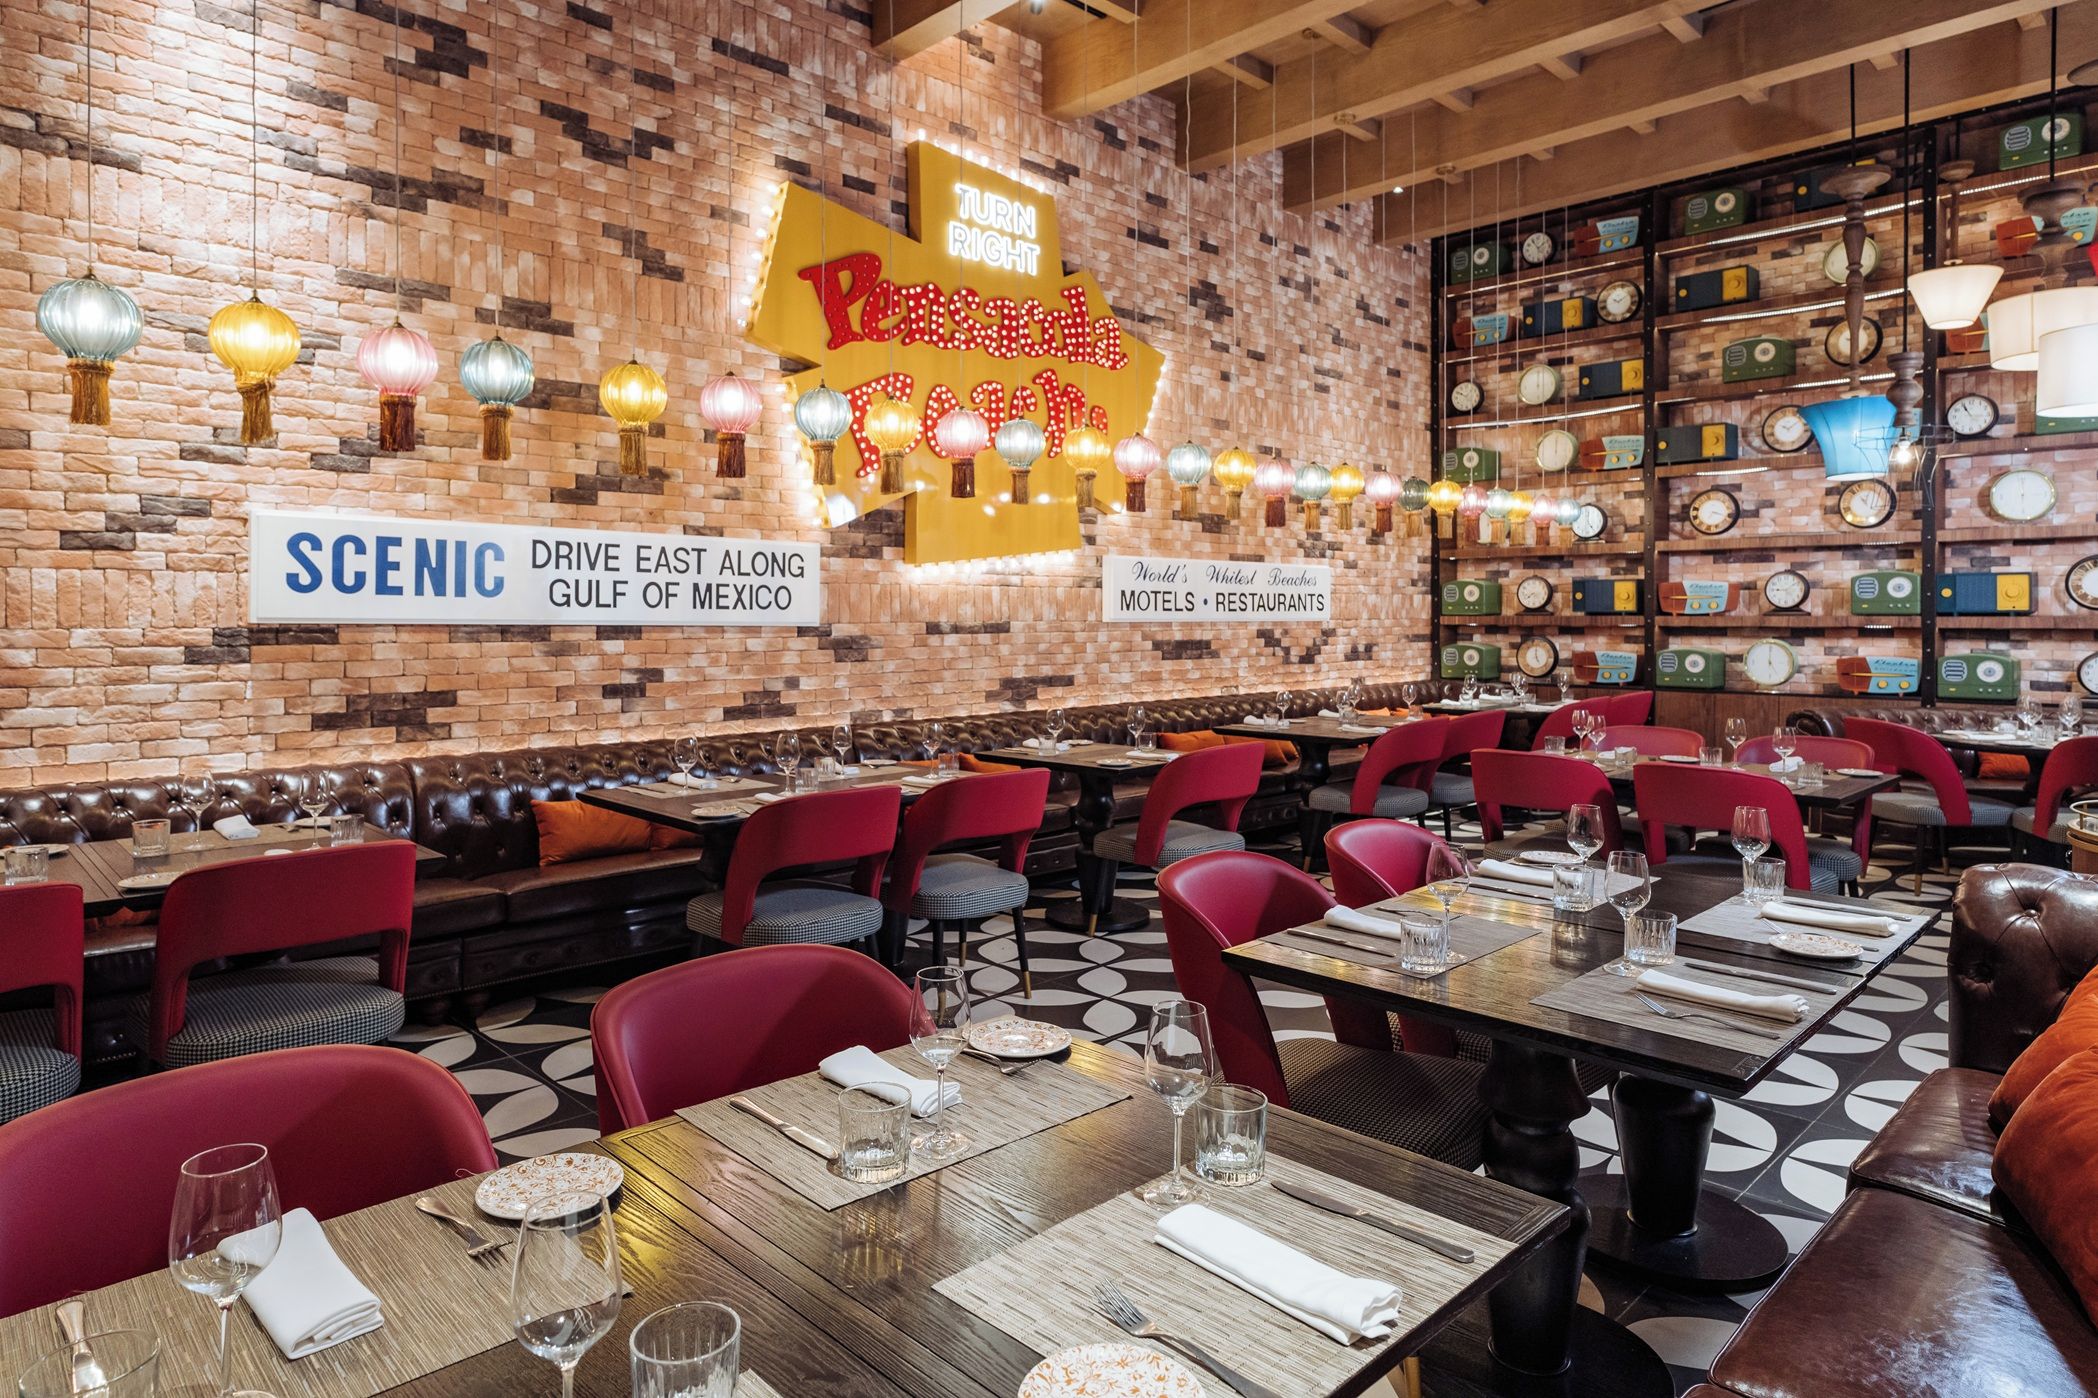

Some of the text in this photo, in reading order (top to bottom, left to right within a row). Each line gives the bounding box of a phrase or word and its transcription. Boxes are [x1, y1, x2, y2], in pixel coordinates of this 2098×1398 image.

[954, 183, 1036, 239] TURN
[948, 220, 1040, 276] RIGHT
[798, 253, 1128, 371] Pensacola
[285, 531, 505, 598] SCENIC
[531, 539, 805, 579] DRIVE EAST ALONG
[1131, 561, 1318, 587] World's Whitest Beaches
[548, 578, 793, 611] GULF OF MEXICO
[1120, 589, 1325, 612] MOTELS RESTAURANTS
